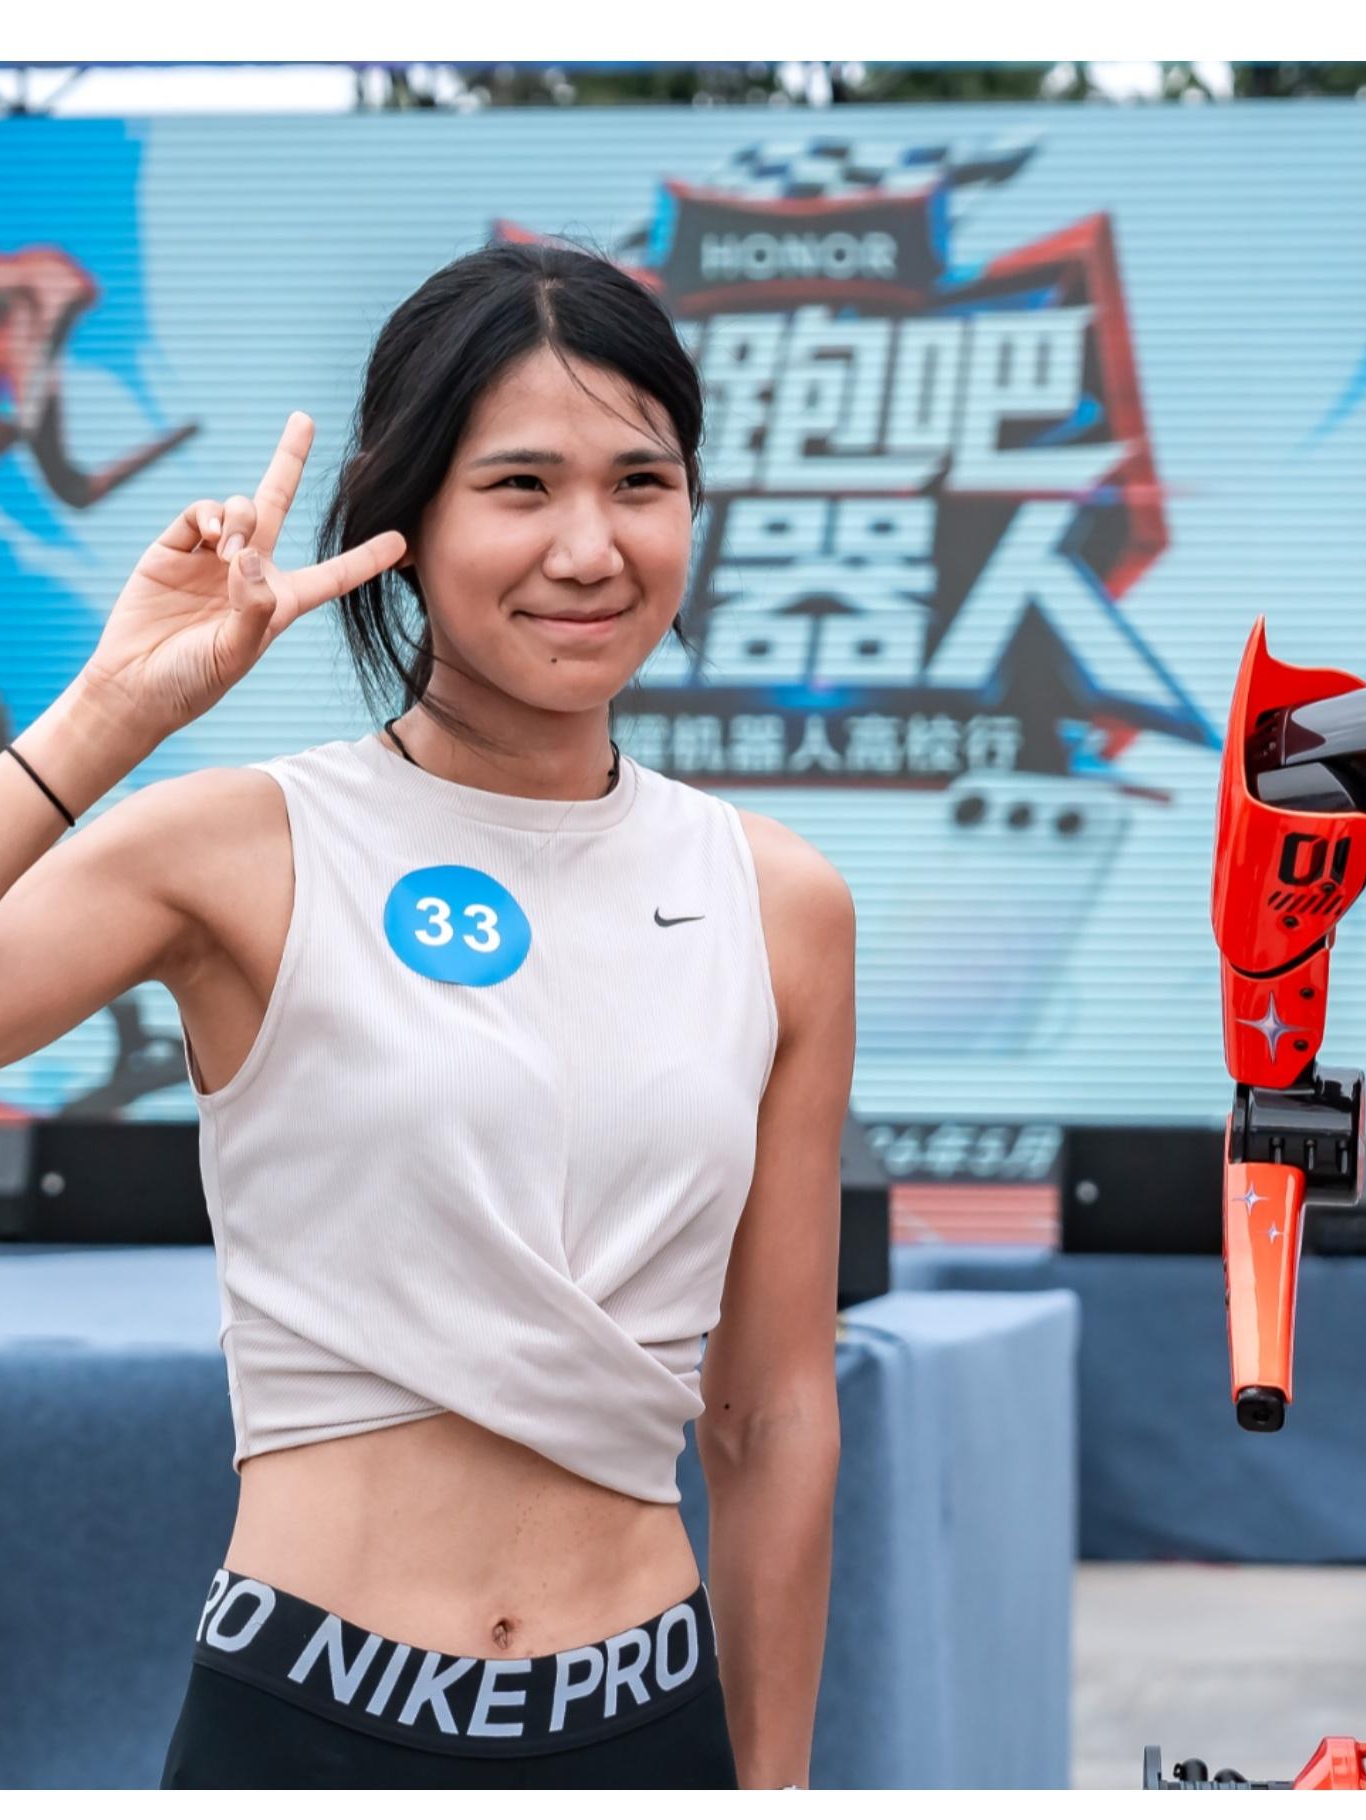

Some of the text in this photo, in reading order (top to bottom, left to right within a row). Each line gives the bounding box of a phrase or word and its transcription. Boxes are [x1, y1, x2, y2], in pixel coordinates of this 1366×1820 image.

[701, 231, 898, 279] HONOR
[680, 306, 1135, 490] 跑吧
[413, 895, 502, 954] 33
[288, 1616, 531, 1738] NIKE
[549, 1605, 698, 1734] PRO
